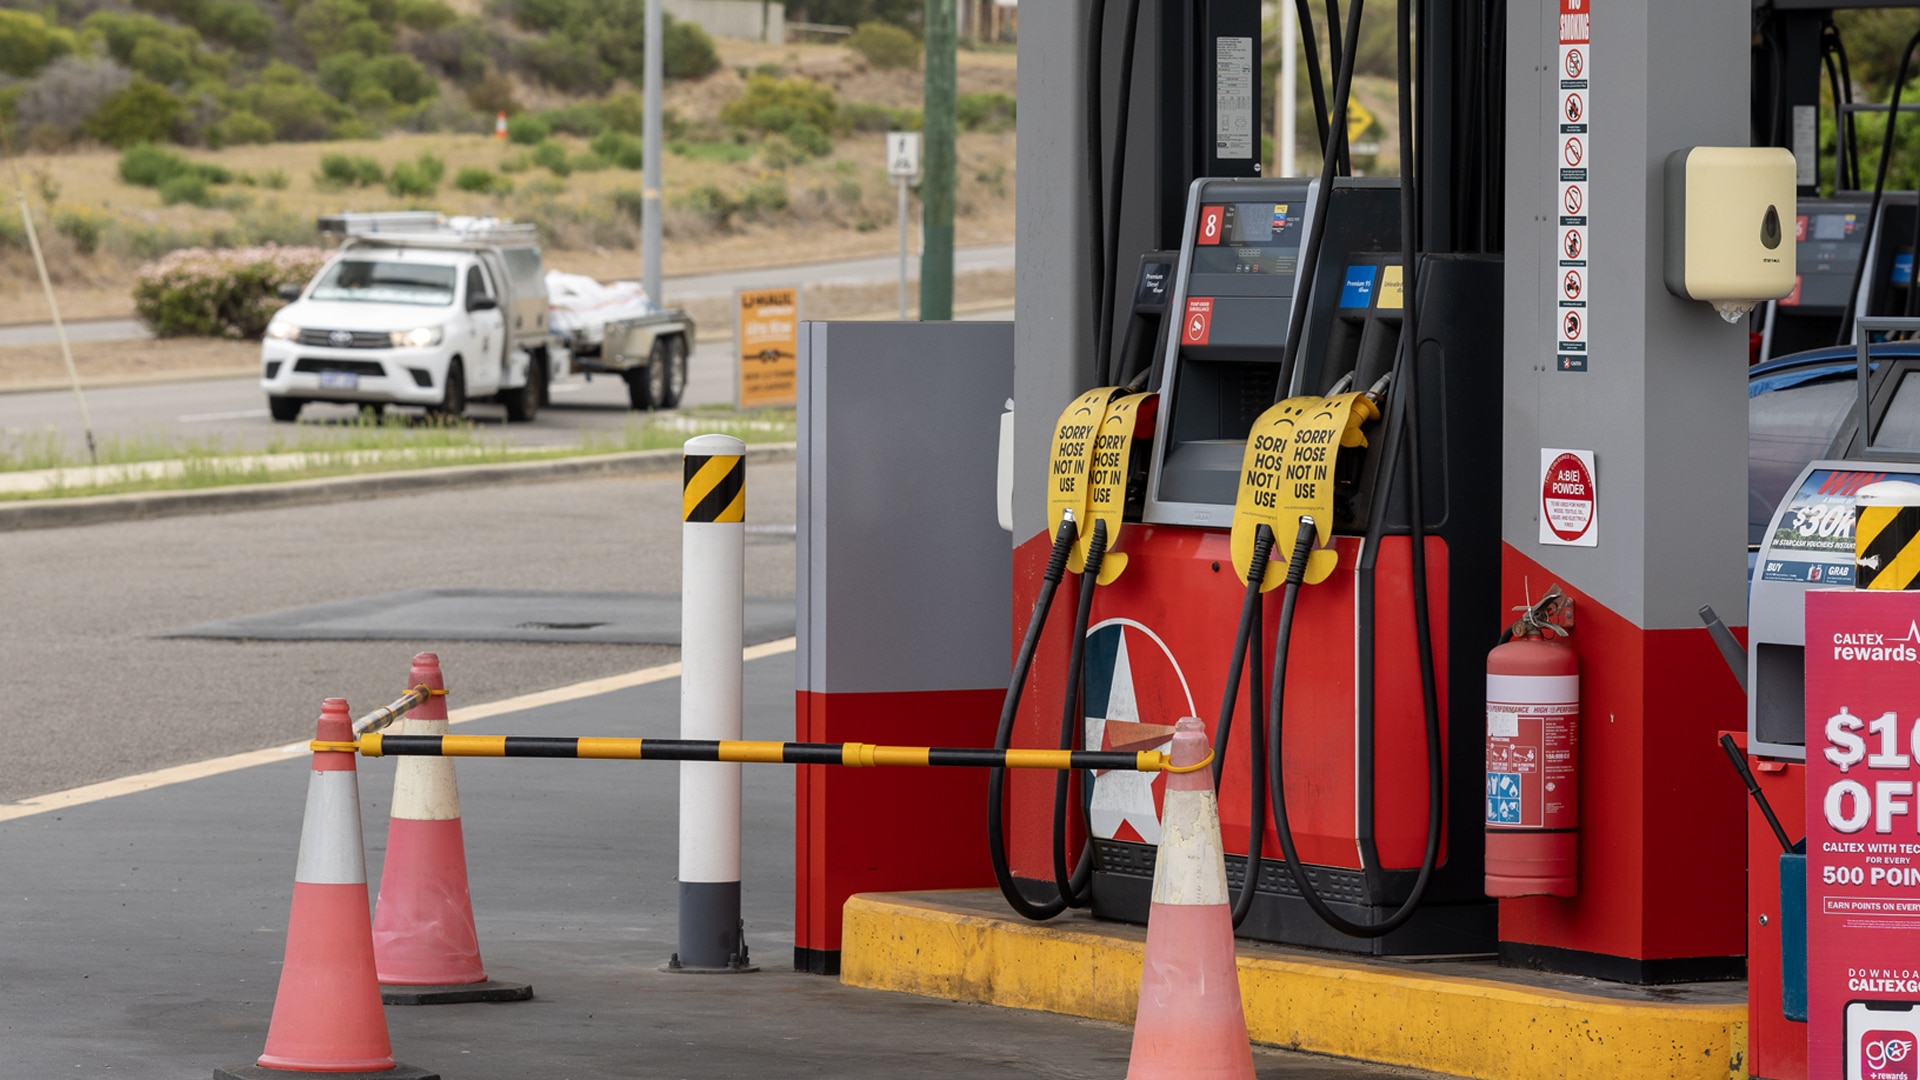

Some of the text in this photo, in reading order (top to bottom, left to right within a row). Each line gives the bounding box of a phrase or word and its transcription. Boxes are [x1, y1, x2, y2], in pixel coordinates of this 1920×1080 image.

[1560, 13, 1589, 41] SMOKING
[1205, 213, 1217, 237] 8
[1059, 425, 1094, 440] SORRY
[1294, 429, 1336, 444] SORRY
[1059, 442, 1085, 457] HOSE
[1093, 435, 1126, 450] SORRY
[1093, 452, 1120, 467] HOSE
[1293, 446, 1327, 462] HOSE
[1053, 460, 1085, 475] NOT IN
[1254, 453, 1282, 471] HOS
[1088, 470, 1121, 485] NOT IN
[1286, 464, 1327, 480] NOT IN
[1059, 477, 1075, 492] USE
[1246, 470, 1280, 490] NOT I
[1093, 488, 1111, 503] USE
[1294, 483, 1316, 499] USE
[1552, 482, 1585, 495] POWDER
[1254, 490, 1277, 508] USE
[1779, 539, 1807, 547] STARCASH
[1807, 540, 1834, 548] VOUCHERS
[1766, 562, 1784, 572] BUY
[1828, 566, 1850, 576] GRAB
[1833, 633, 1883, 645] CALTEX
[1833, 644, 1917, 661] rewards
[1492, 705, 1530, 713] PERFORMANCE
[1823, 706, 1920, 773] $1
[1823, 779, 1920, 835] OF
[1822, 842, 1920, 854] CALTEX WITH TEC
[1865, 856, 1882, 864] FOR
[1822, 866, 1864, 885] 500
[1827, 901, 1850, 909] EARN
[1851, 902, 1881, 910] POINTS
[1848, 968, 1920, 979] DOWNLOA
[1848, 978, 1920, 992] CALTEXG
